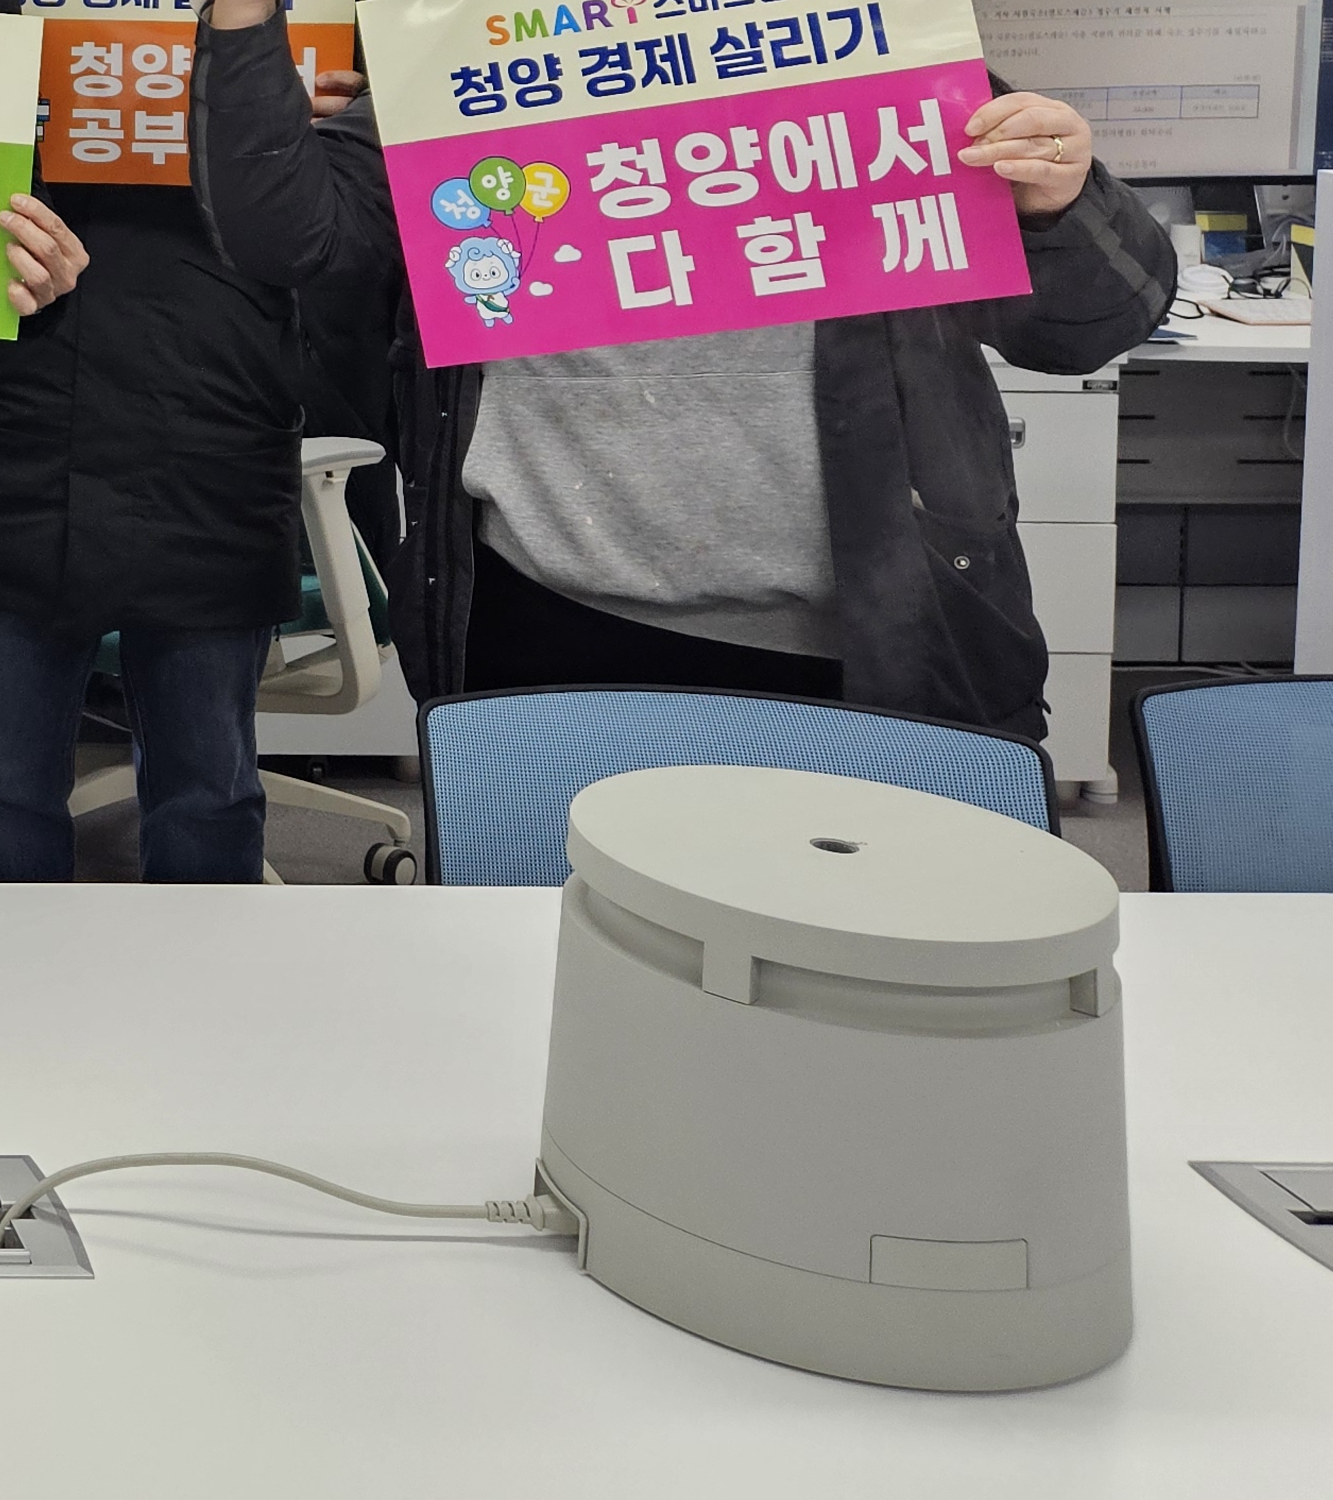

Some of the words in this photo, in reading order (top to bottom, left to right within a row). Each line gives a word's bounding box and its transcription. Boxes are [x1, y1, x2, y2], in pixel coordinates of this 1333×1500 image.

[449, 59, 565, 119] 청양
[578, 38, 697, 99] 경제
[711, 2, 891, 81] 살리기
[69, 109, 188, 165] 공부
[586, 97, 952, 220] 청양에서
